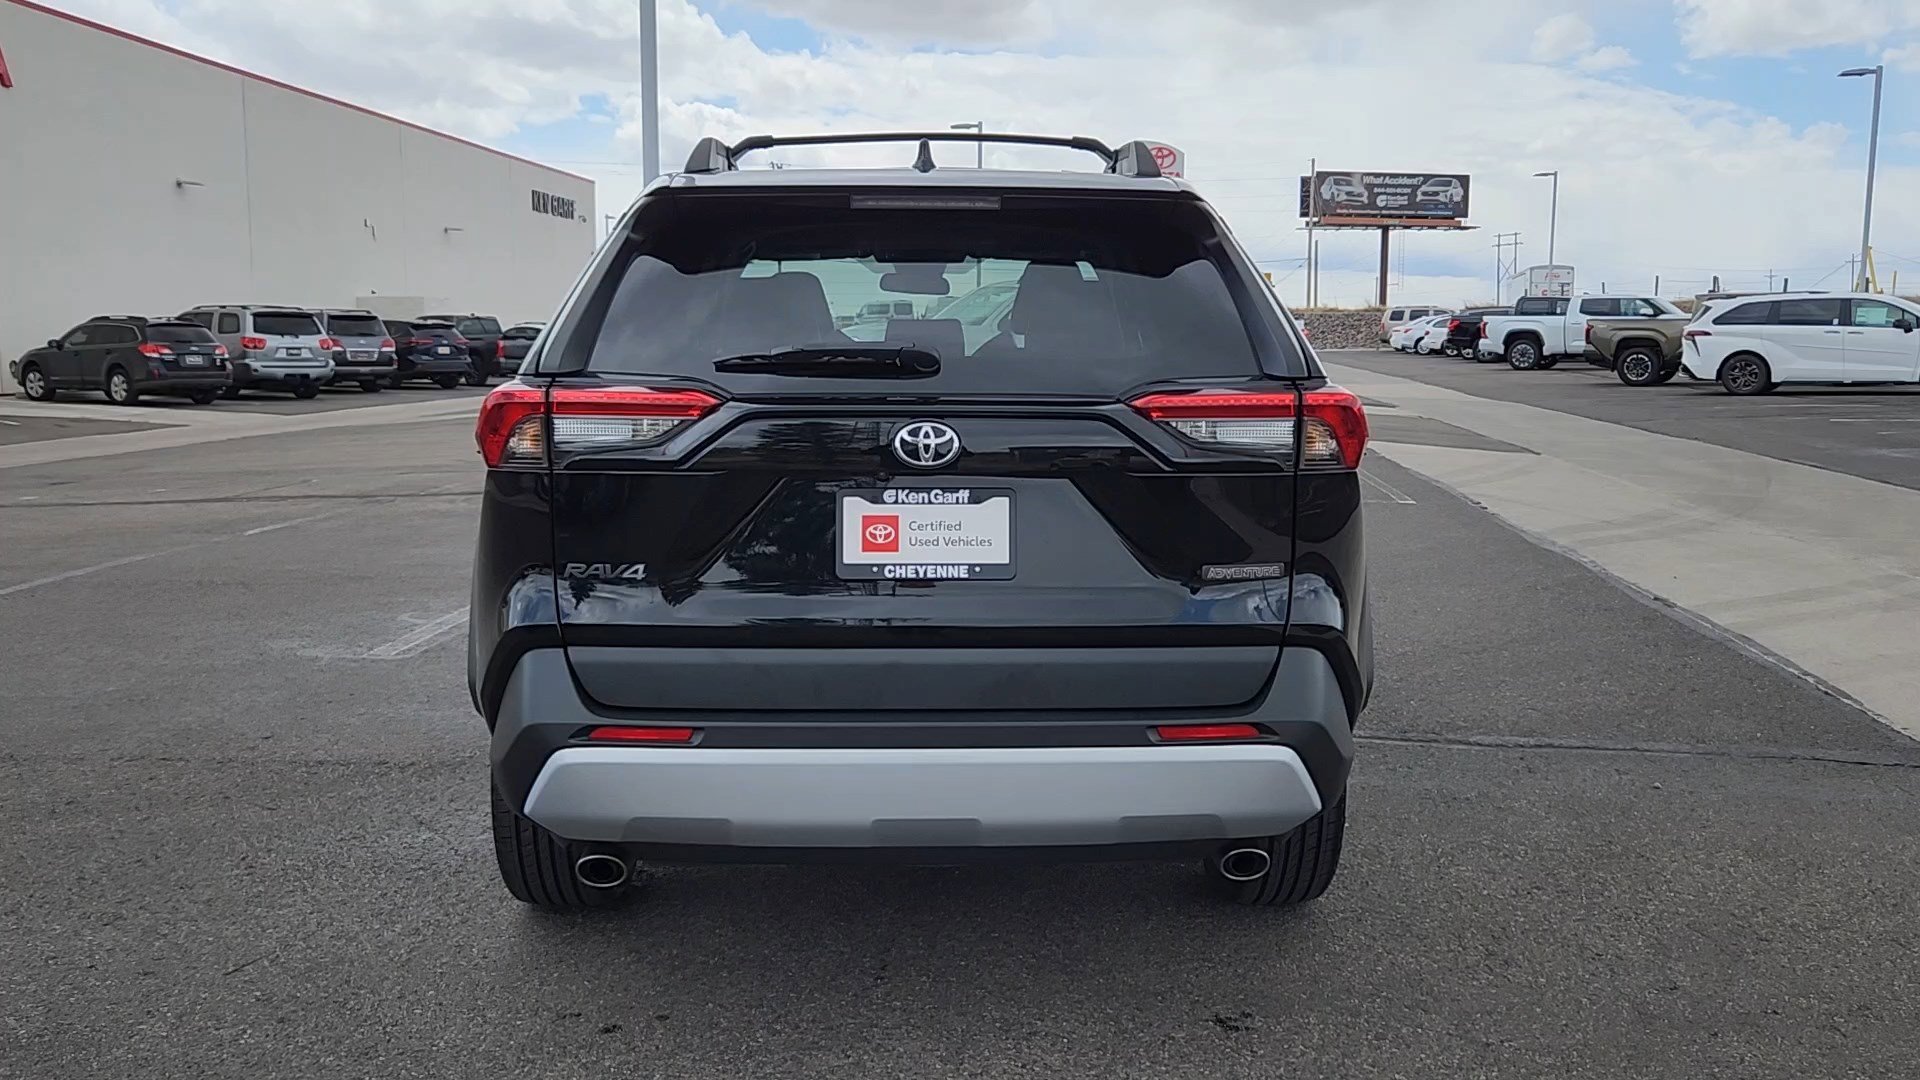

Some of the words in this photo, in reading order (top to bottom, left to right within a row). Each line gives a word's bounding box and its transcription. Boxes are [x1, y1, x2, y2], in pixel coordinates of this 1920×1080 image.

[1363, 175, 1384, 184] What
[1384, 176, 1424, 185] Accident?
[897, 490, 928, 503] Ken
[930, 489, 970, 504] Garff
[908, 520, 962, 532] Certified
[908, 536, 940, 547] Used
[942, 536, 993, 547] Vehicles
[563, 562, 648, 580] RAV4
[883, 565, 969, 579] CHEYENNE
[1206, 566, 1281, 579] ADVENTURE
